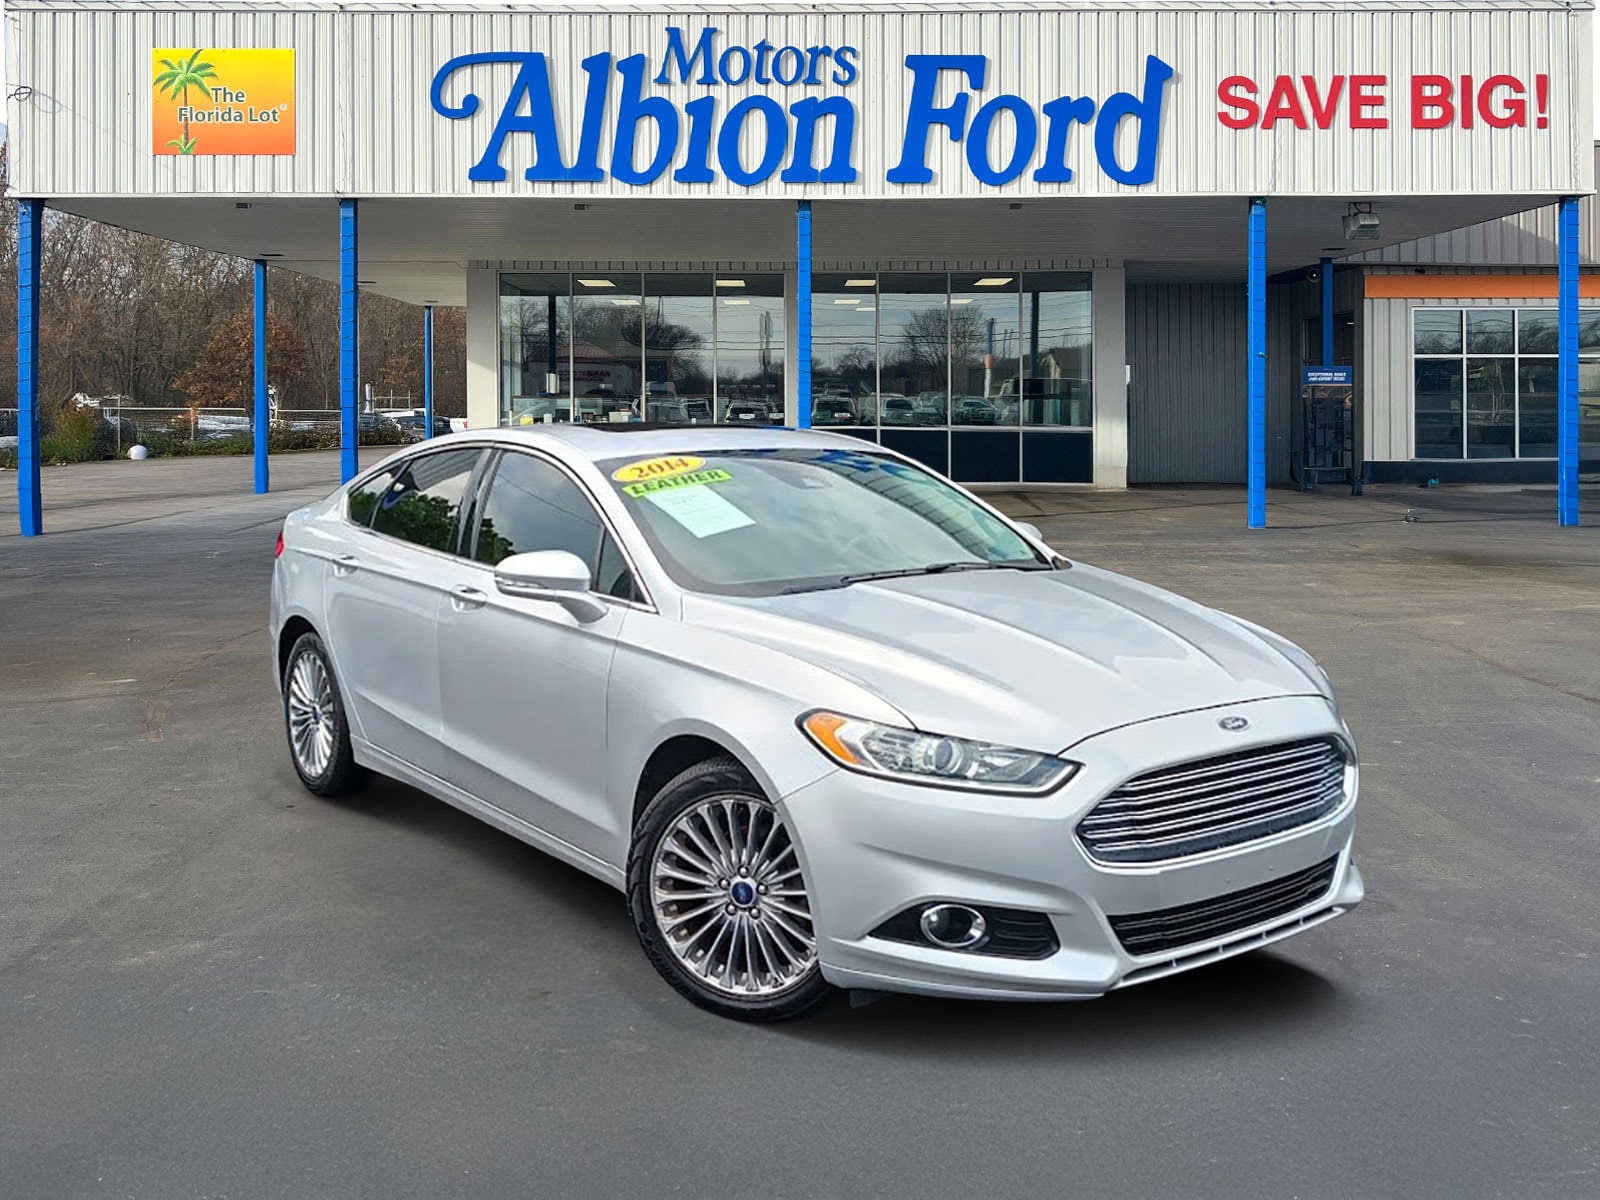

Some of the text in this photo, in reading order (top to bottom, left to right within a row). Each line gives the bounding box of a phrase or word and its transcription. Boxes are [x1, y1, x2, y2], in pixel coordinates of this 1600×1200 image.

[655, 27, 857, 85] Motors
[211, 87, 245, 103] The
[1217, 75, 1548, 129] SAVE BIG!
[178, 106, 279, 122] Florida Lot
[430, 52, 1174, 186] Albion Ford
[629, 457, 689, 479] 2014
[631, 469, 723, 496] LEATHER
